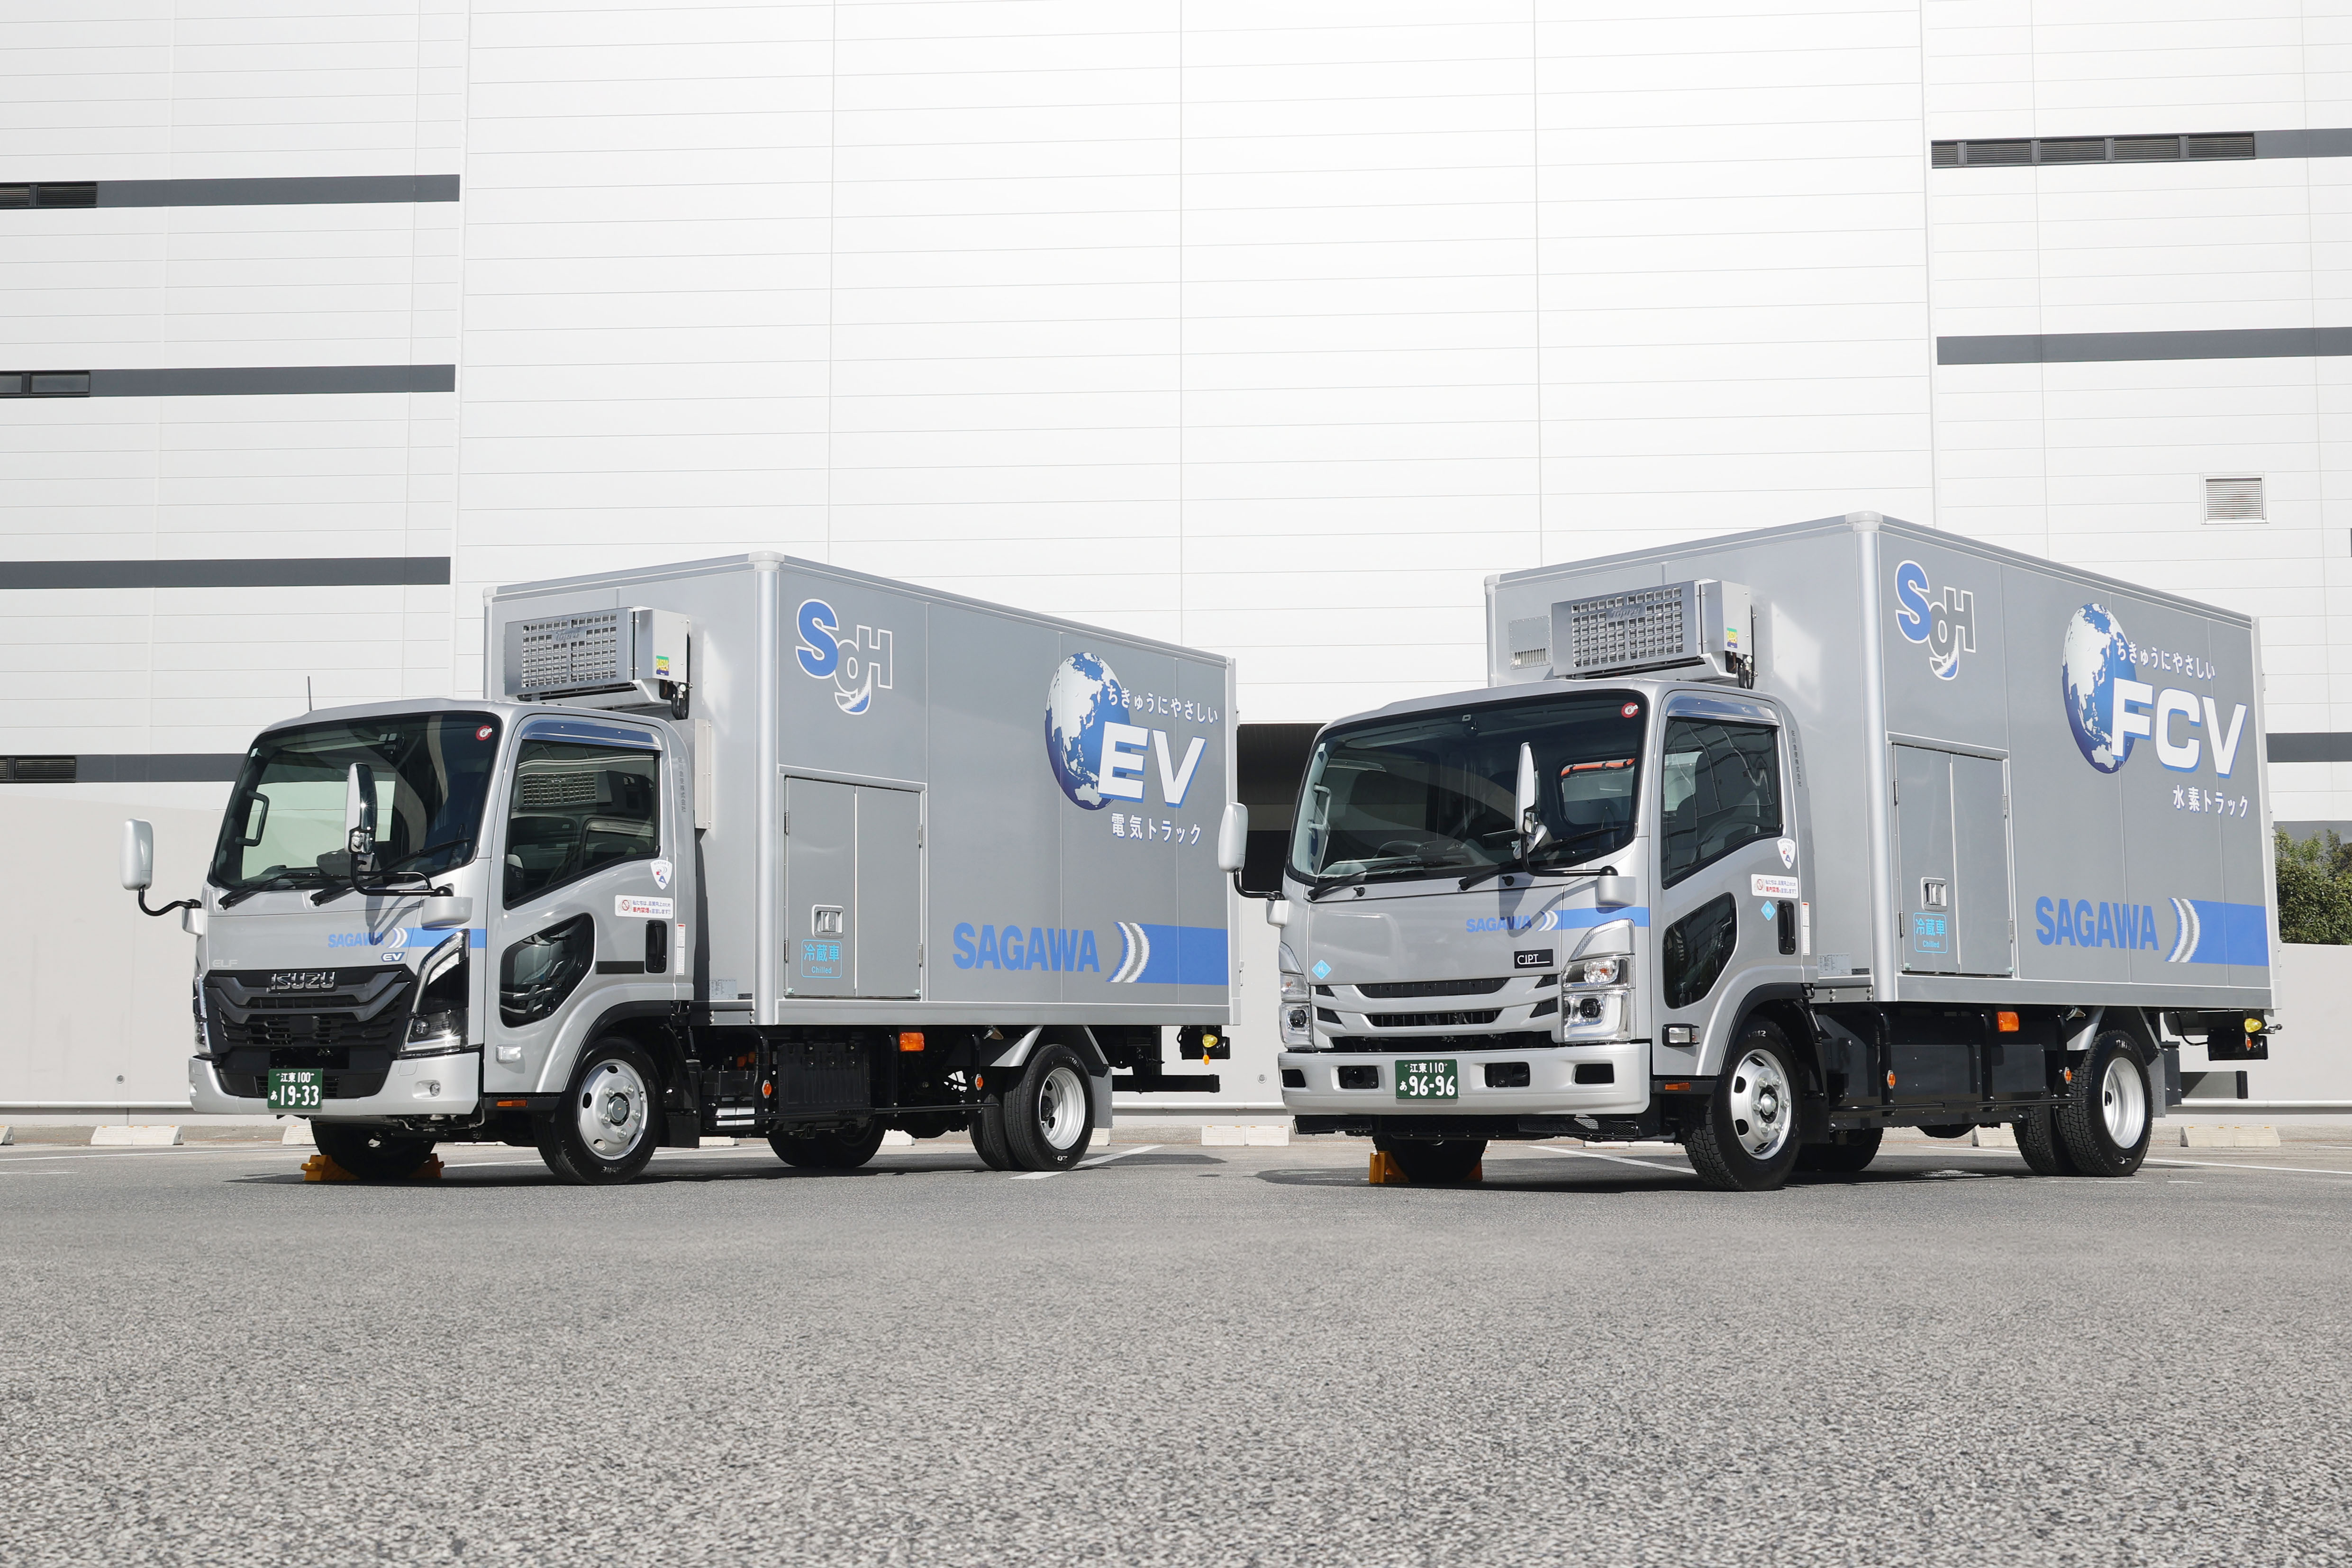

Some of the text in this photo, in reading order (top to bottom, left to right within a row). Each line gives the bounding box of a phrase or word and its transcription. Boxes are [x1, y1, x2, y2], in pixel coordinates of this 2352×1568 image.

[2116, 638, 2216, 680] ちきゅうにやさしい
[1107, 685, 1218, 724] ちきゅうにやさしい
[2111, 677, 2247, 778] FCV
[1097, 722, 1206, 808] EV
[2172, 784, 2249, 819] 水素トラック
[1111, 812, 1202, 845] 電気トラック
[1466, 915, 1533, 933] SAGAWA
[1916, 918, 1945, 936] 冷蔵車
[2035, 896, 2159, 951] SAGAWA
[328, 932, 384, 947] SAGAWA
[804, 943, 840, 962] 冷蔵車
[953, 922, 1100, 972] SAGAWA
[382, 953, 402, 961] EV
[270, 971, 336, 990] ISUZU
[270, 1085, 319, 1106] あ 19-33
[1399, 1075, 1455, 1096] あ 96-96
